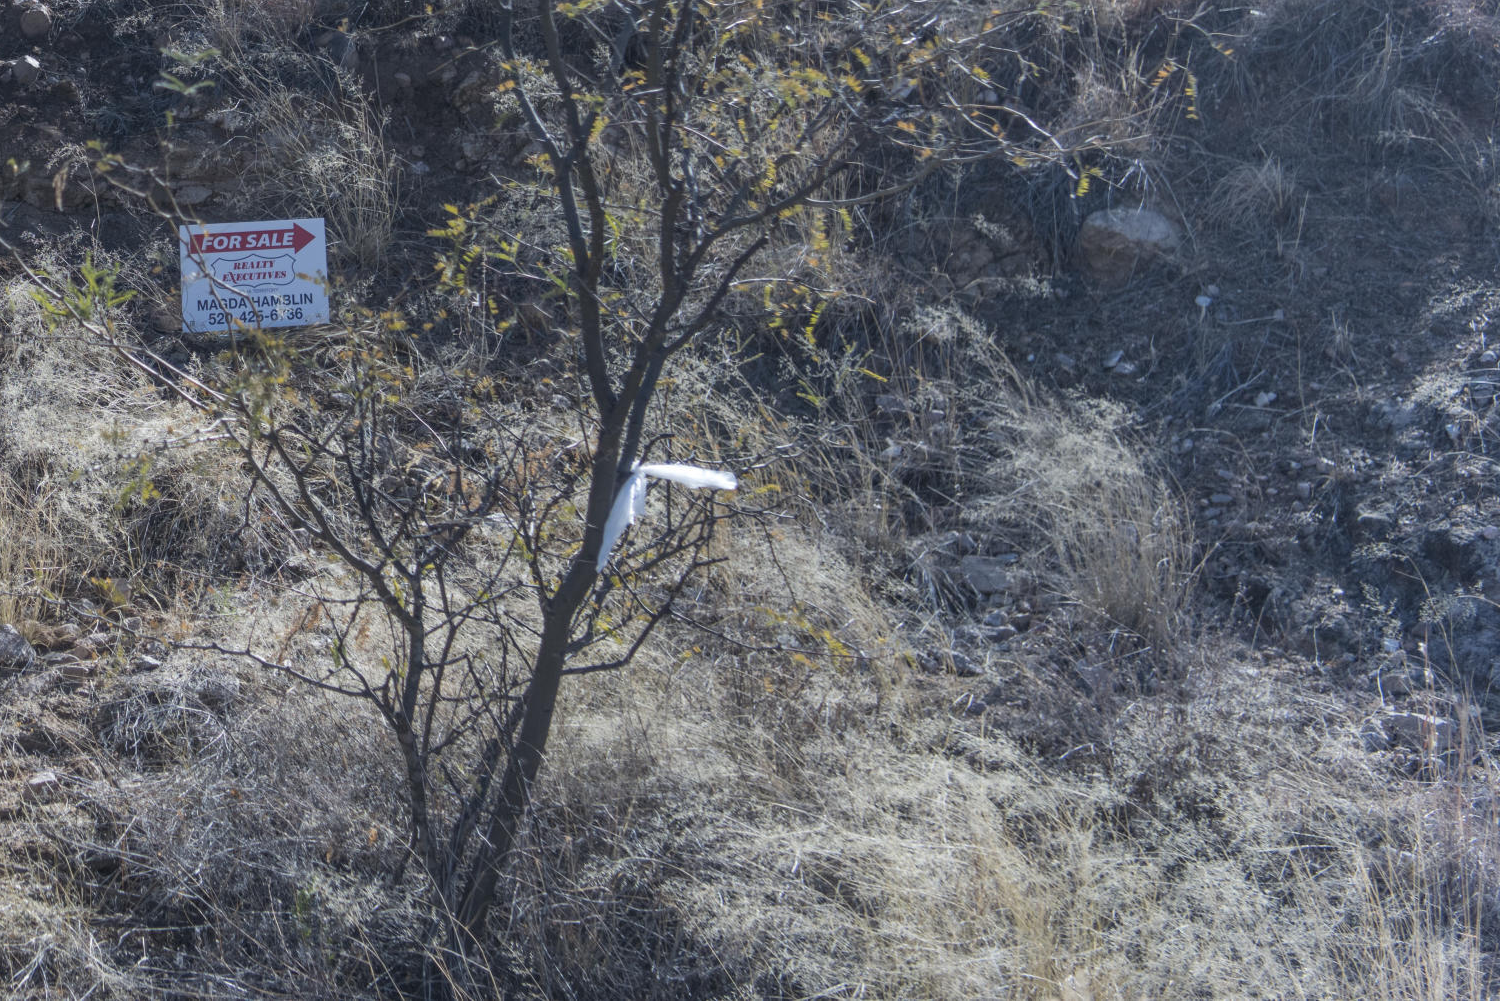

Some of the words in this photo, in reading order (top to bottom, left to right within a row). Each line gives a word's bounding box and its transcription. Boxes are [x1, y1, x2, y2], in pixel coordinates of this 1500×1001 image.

[201, 235, 241, 251] FOR
[245, 232, 295, 248] SALE
[233, 260, 276, 270] REALTY
[222, 270, 287, 284] EXECUTIVES
[197, 297, 248, 311] MAGDA
[251, 293, 313, 309] HAMBLIN
[208, 307, 303, 325] 520425-636
